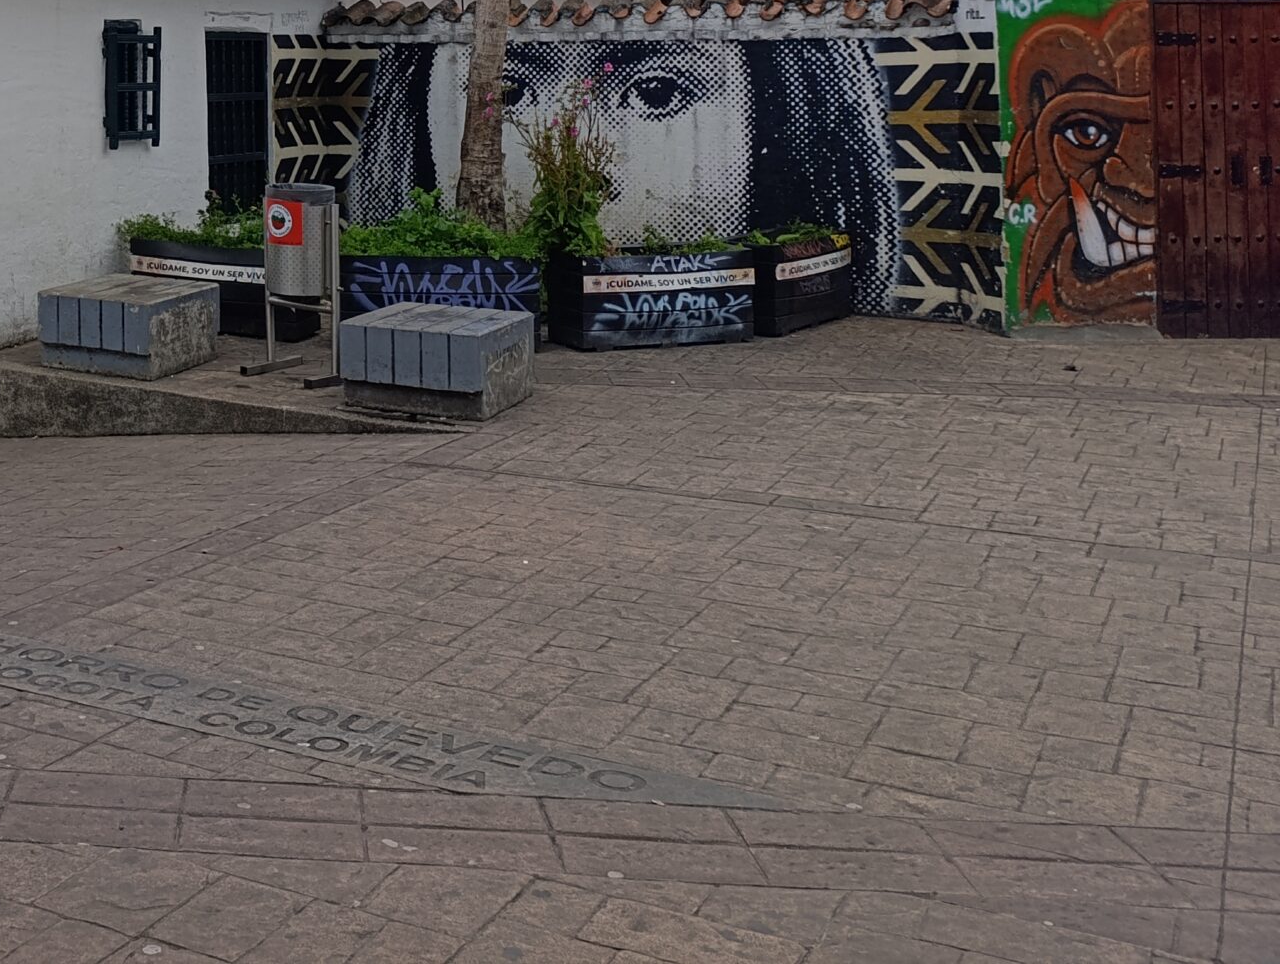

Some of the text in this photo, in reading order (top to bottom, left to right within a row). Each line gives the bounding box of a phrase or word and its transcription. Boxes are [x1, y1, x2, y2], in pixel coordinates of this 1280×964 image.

[191, 267, 210, 276] SOY
[658, 279, 675, 287] SOY
[678, 278, 691, 286] UN
[693, 276, 712, 285] SER
[197, 687, 273, 710] DE
[286, 704, 647, 792] QUEVEDO
[198, 712, 486, 789] COLOMBIA
